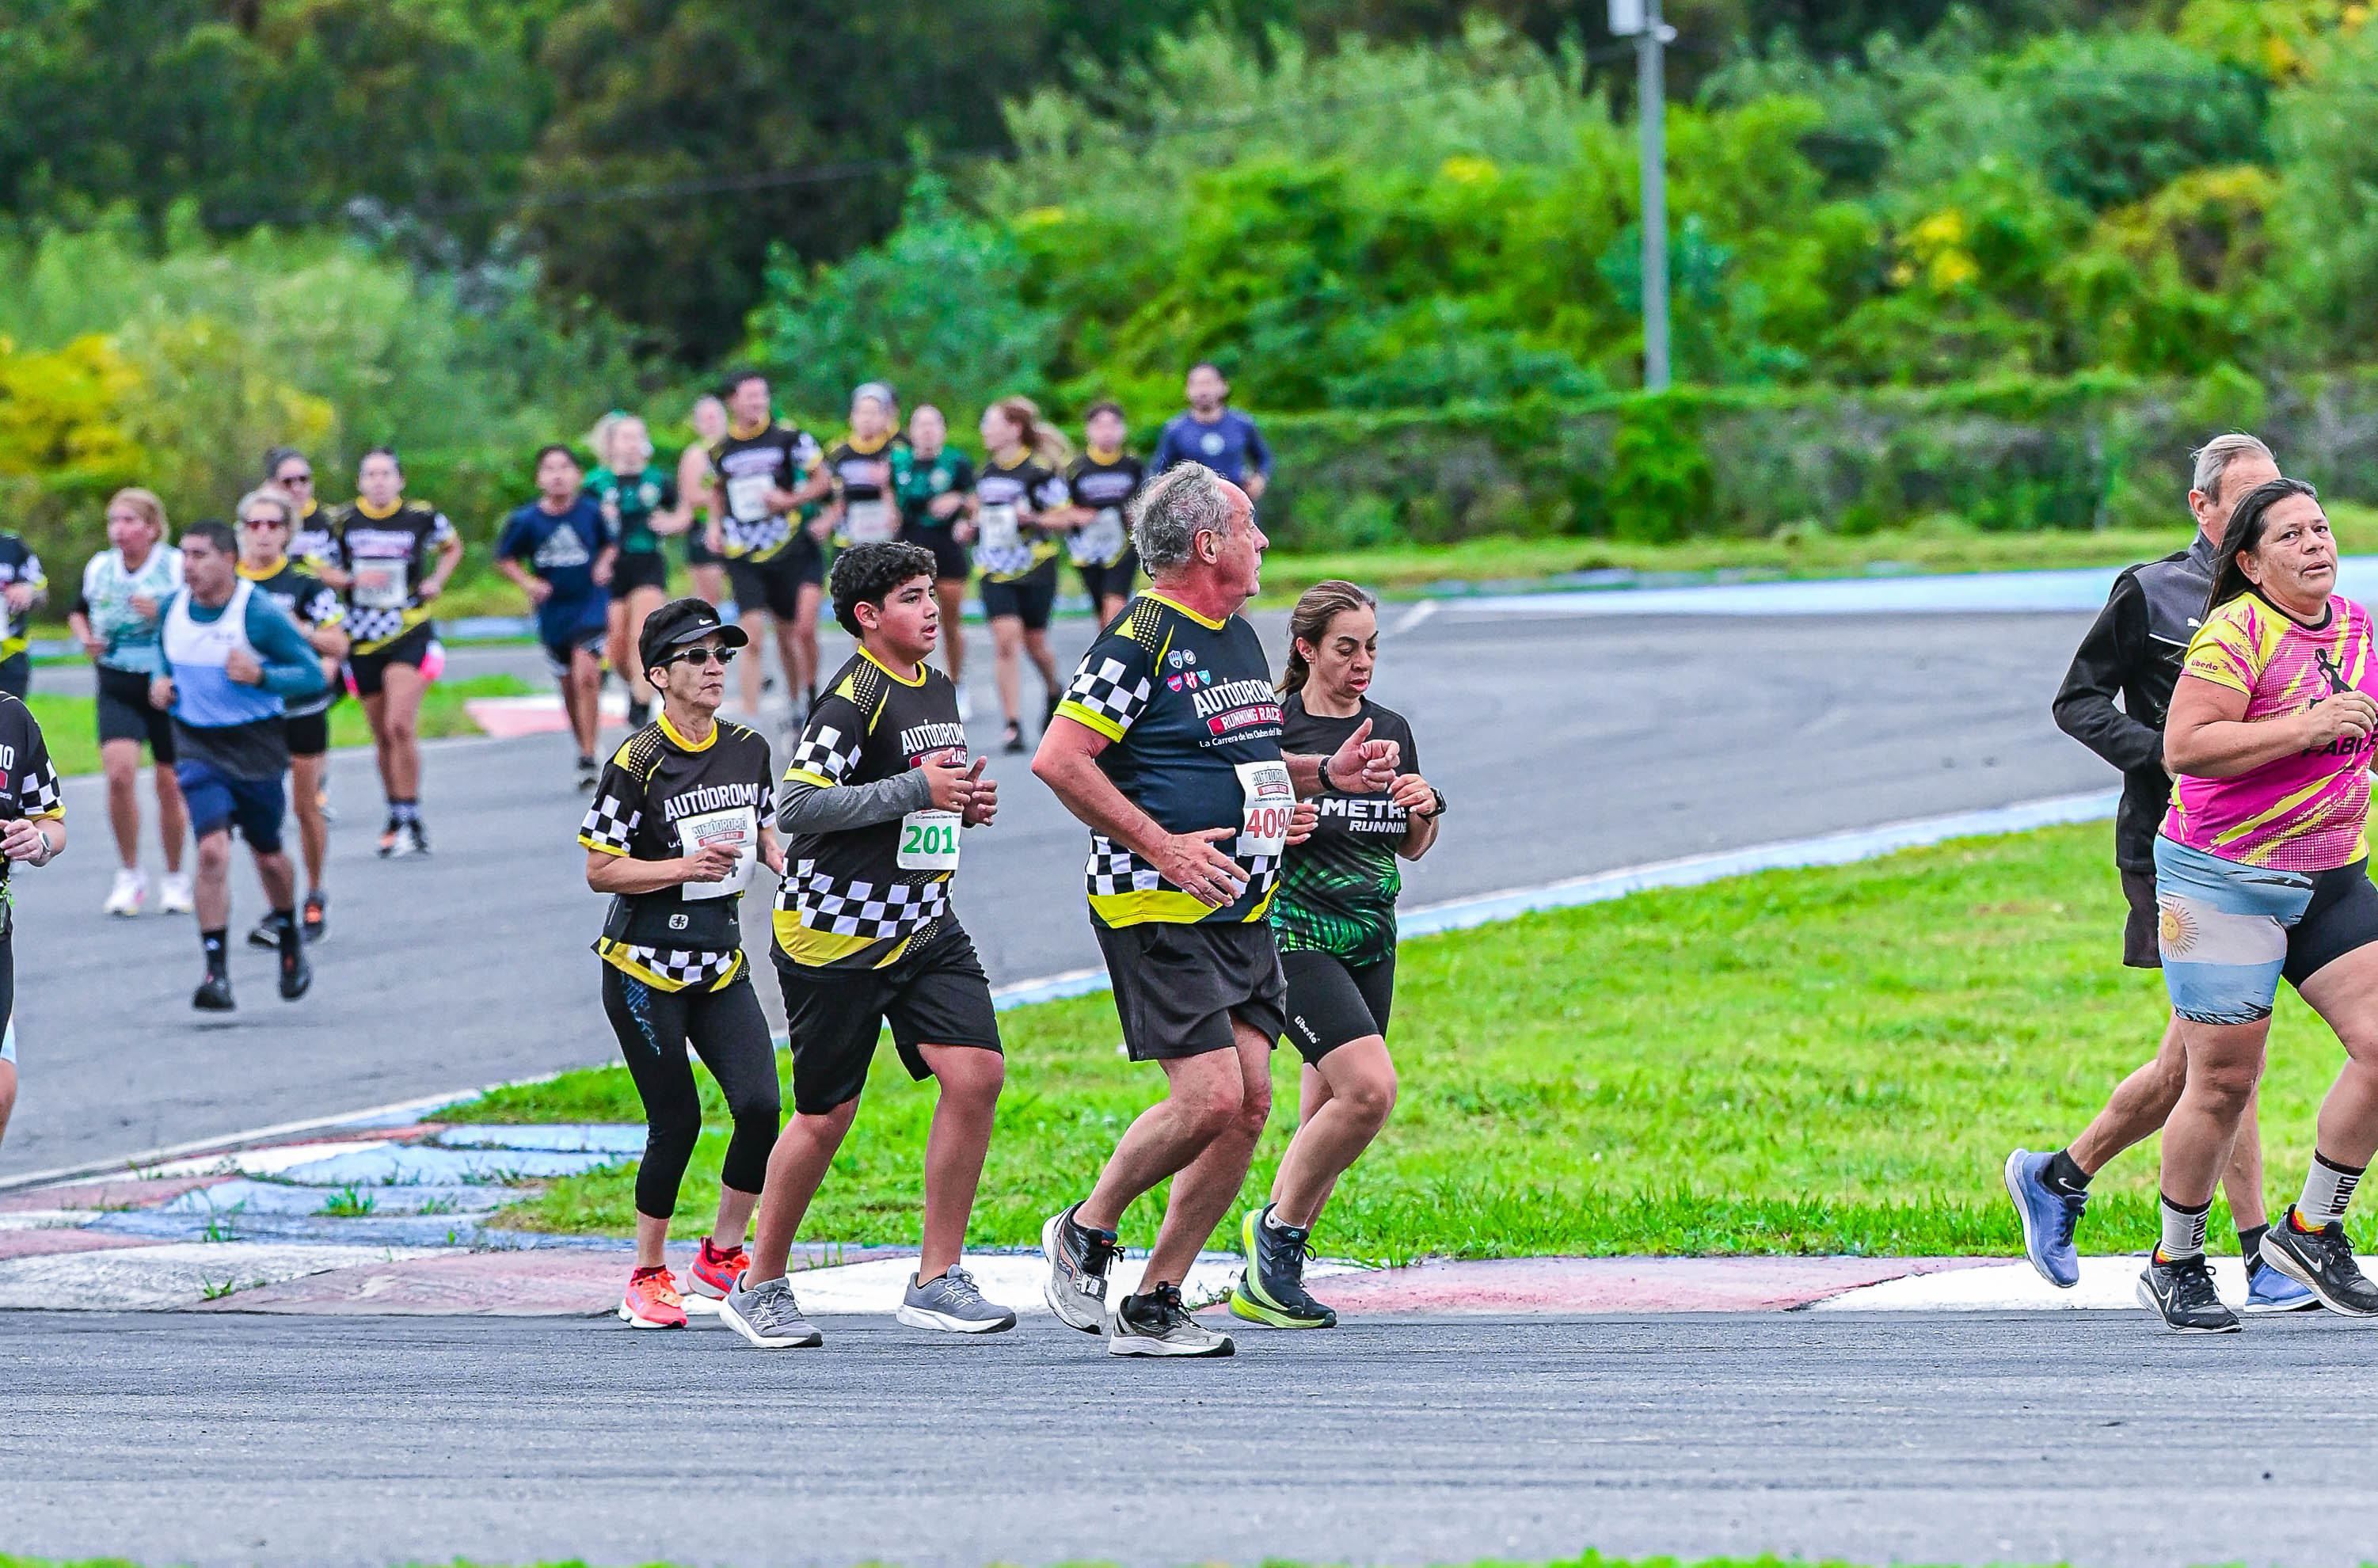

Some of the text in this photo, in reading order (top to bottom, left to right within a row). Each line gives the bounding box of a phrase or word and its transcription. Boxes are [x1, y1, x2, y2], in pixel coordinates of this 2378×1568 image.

[1192, 677, 1276, 719] AUTÓDROM
[1220, 708, 1258, 729] RUNNING
[900, 718, 967, 756] AUTÓDROM
[1212, 734, 1238, 746] Carrera
[903, 825, 961, 854] 201
[1349, 820, 1407, 834] RUNNIN
[1294, 1015, 1318, 1044] Liberto
